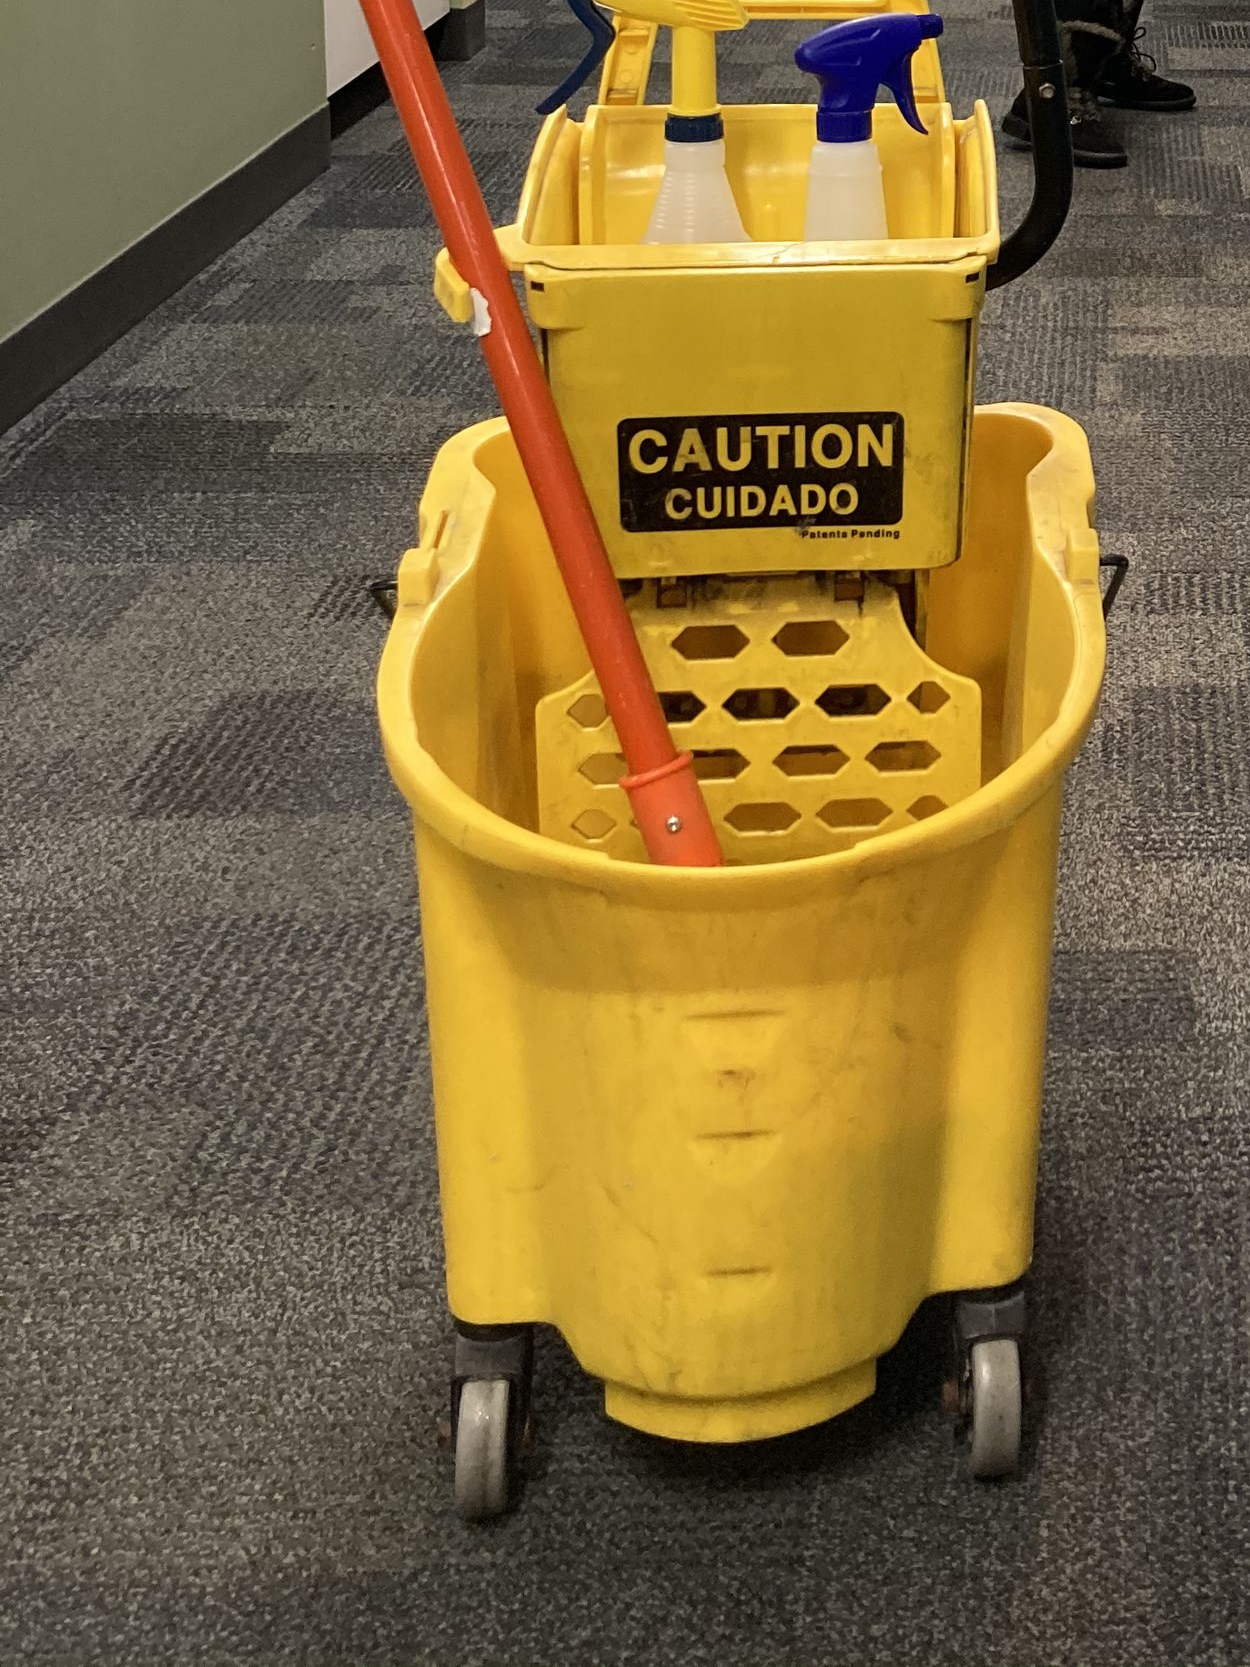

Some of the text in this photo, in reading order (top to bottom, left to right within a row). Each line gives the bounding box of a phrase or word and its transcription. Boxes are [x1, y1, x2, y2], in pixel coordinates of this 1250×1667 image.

[628, 423, 894, 474] CAUTION
[664, 482, 859, 520] CUIDADO
[801, 528, 900, 540] Patents Pending
